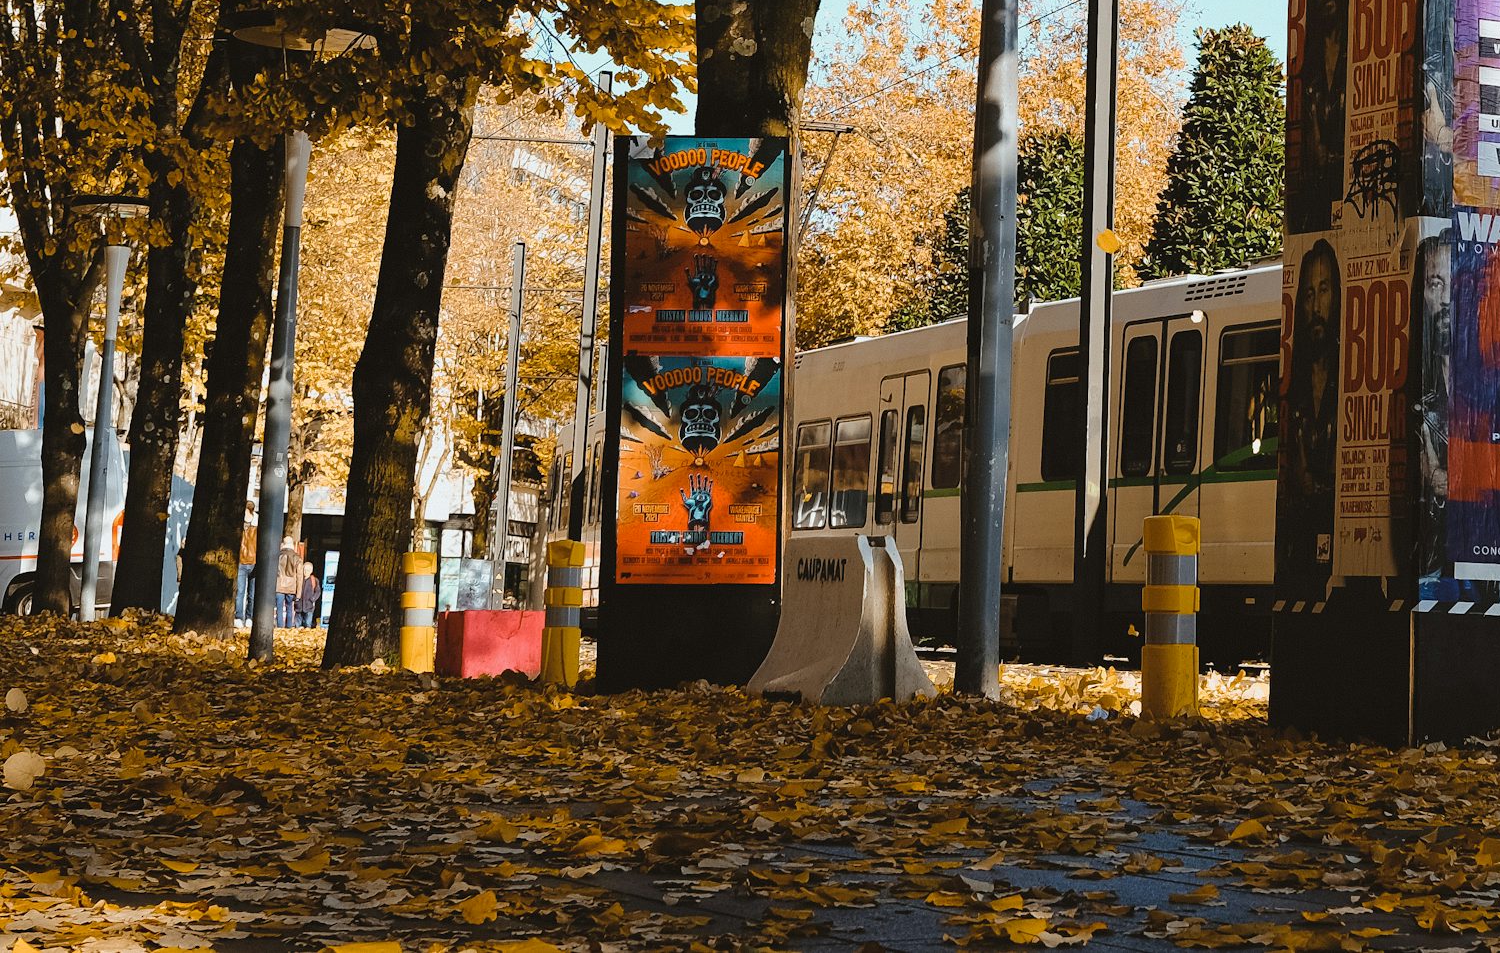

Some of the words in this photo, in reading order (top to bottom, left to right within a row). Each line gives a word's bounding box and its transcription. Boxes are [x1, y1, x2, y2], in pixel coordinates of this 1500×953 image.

[648, 148, 706, 176] VOODOO
[711, 149, 764, 178] PEOPLE
[1347, 262, 1363, 279] SAM
[1365, 259, 1374, 275] 27
[1344, 280, 1409, 393] BOB
[642, 366, 702, 395] VOODOO
[707, 367, 761, 396] PEOPLE
